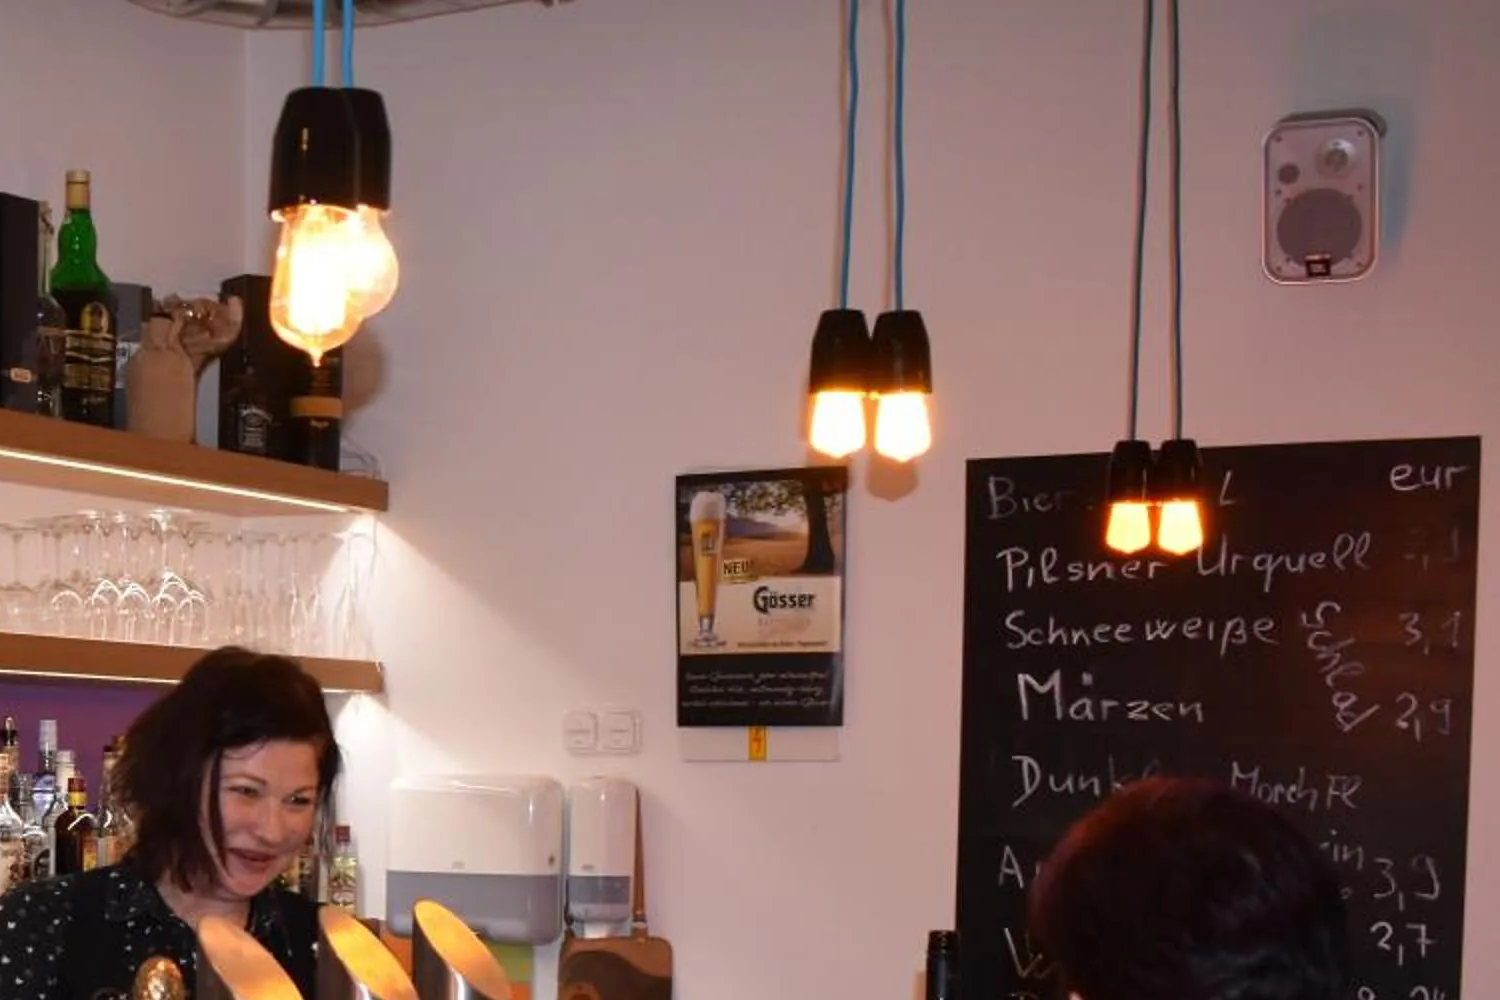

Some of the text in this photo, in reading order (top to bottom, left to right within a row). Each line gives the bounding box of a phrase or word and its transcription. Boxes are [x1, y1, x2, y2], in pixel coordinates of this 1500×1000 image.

[1389, 461, 1471, 492] eur
[996, 544, 1170, 593] Pilsner
[1196, 531, 1372, 593] Urquell
[752, 584, 817, 616] Gösser
[1017, 670, 1206, 724] Märzen
[1011, 754, 1161, 807] Dunk
[1369, 920, 1438, 967] 2,7
